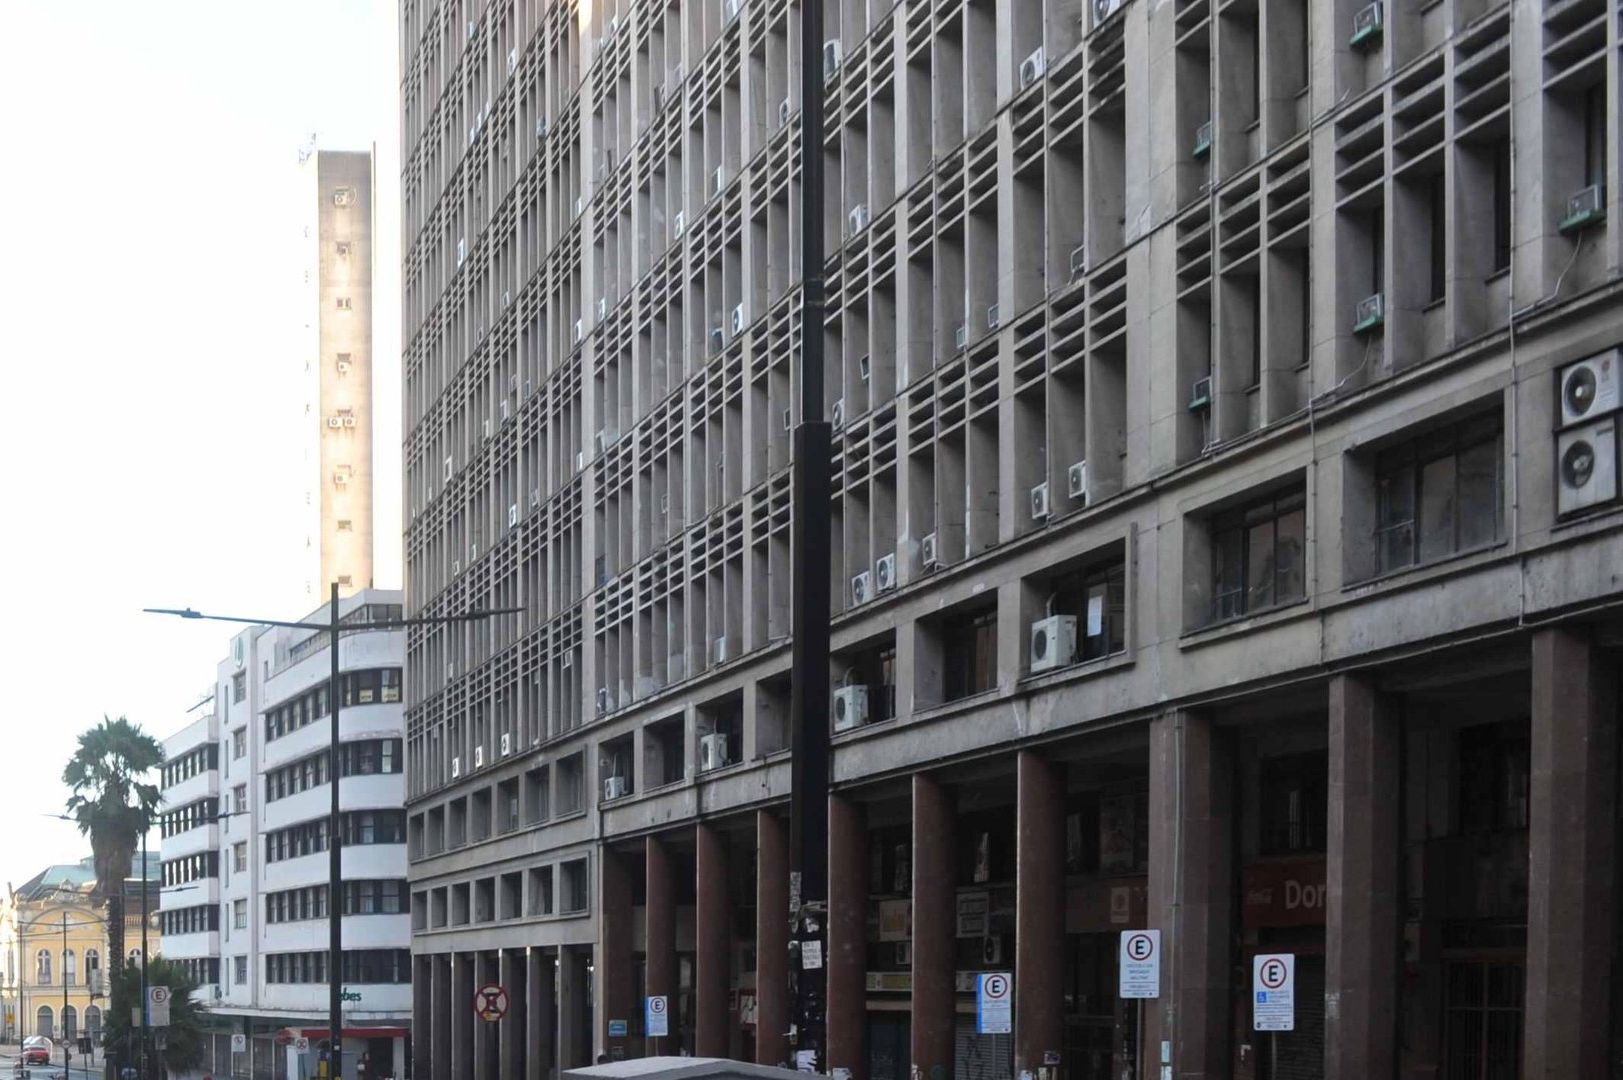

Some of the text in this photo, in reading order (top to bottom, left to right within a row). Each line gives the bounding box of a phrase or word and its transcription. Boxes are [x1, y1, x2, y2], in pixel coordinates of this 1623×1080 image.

[1135, 940, 1145, 955] E
[1269, 965, 1279, 982] E
[991, 979, 1001, 993] E
[155, 990, 162, 1000] E
[655, 1000, 661, 1010] E
